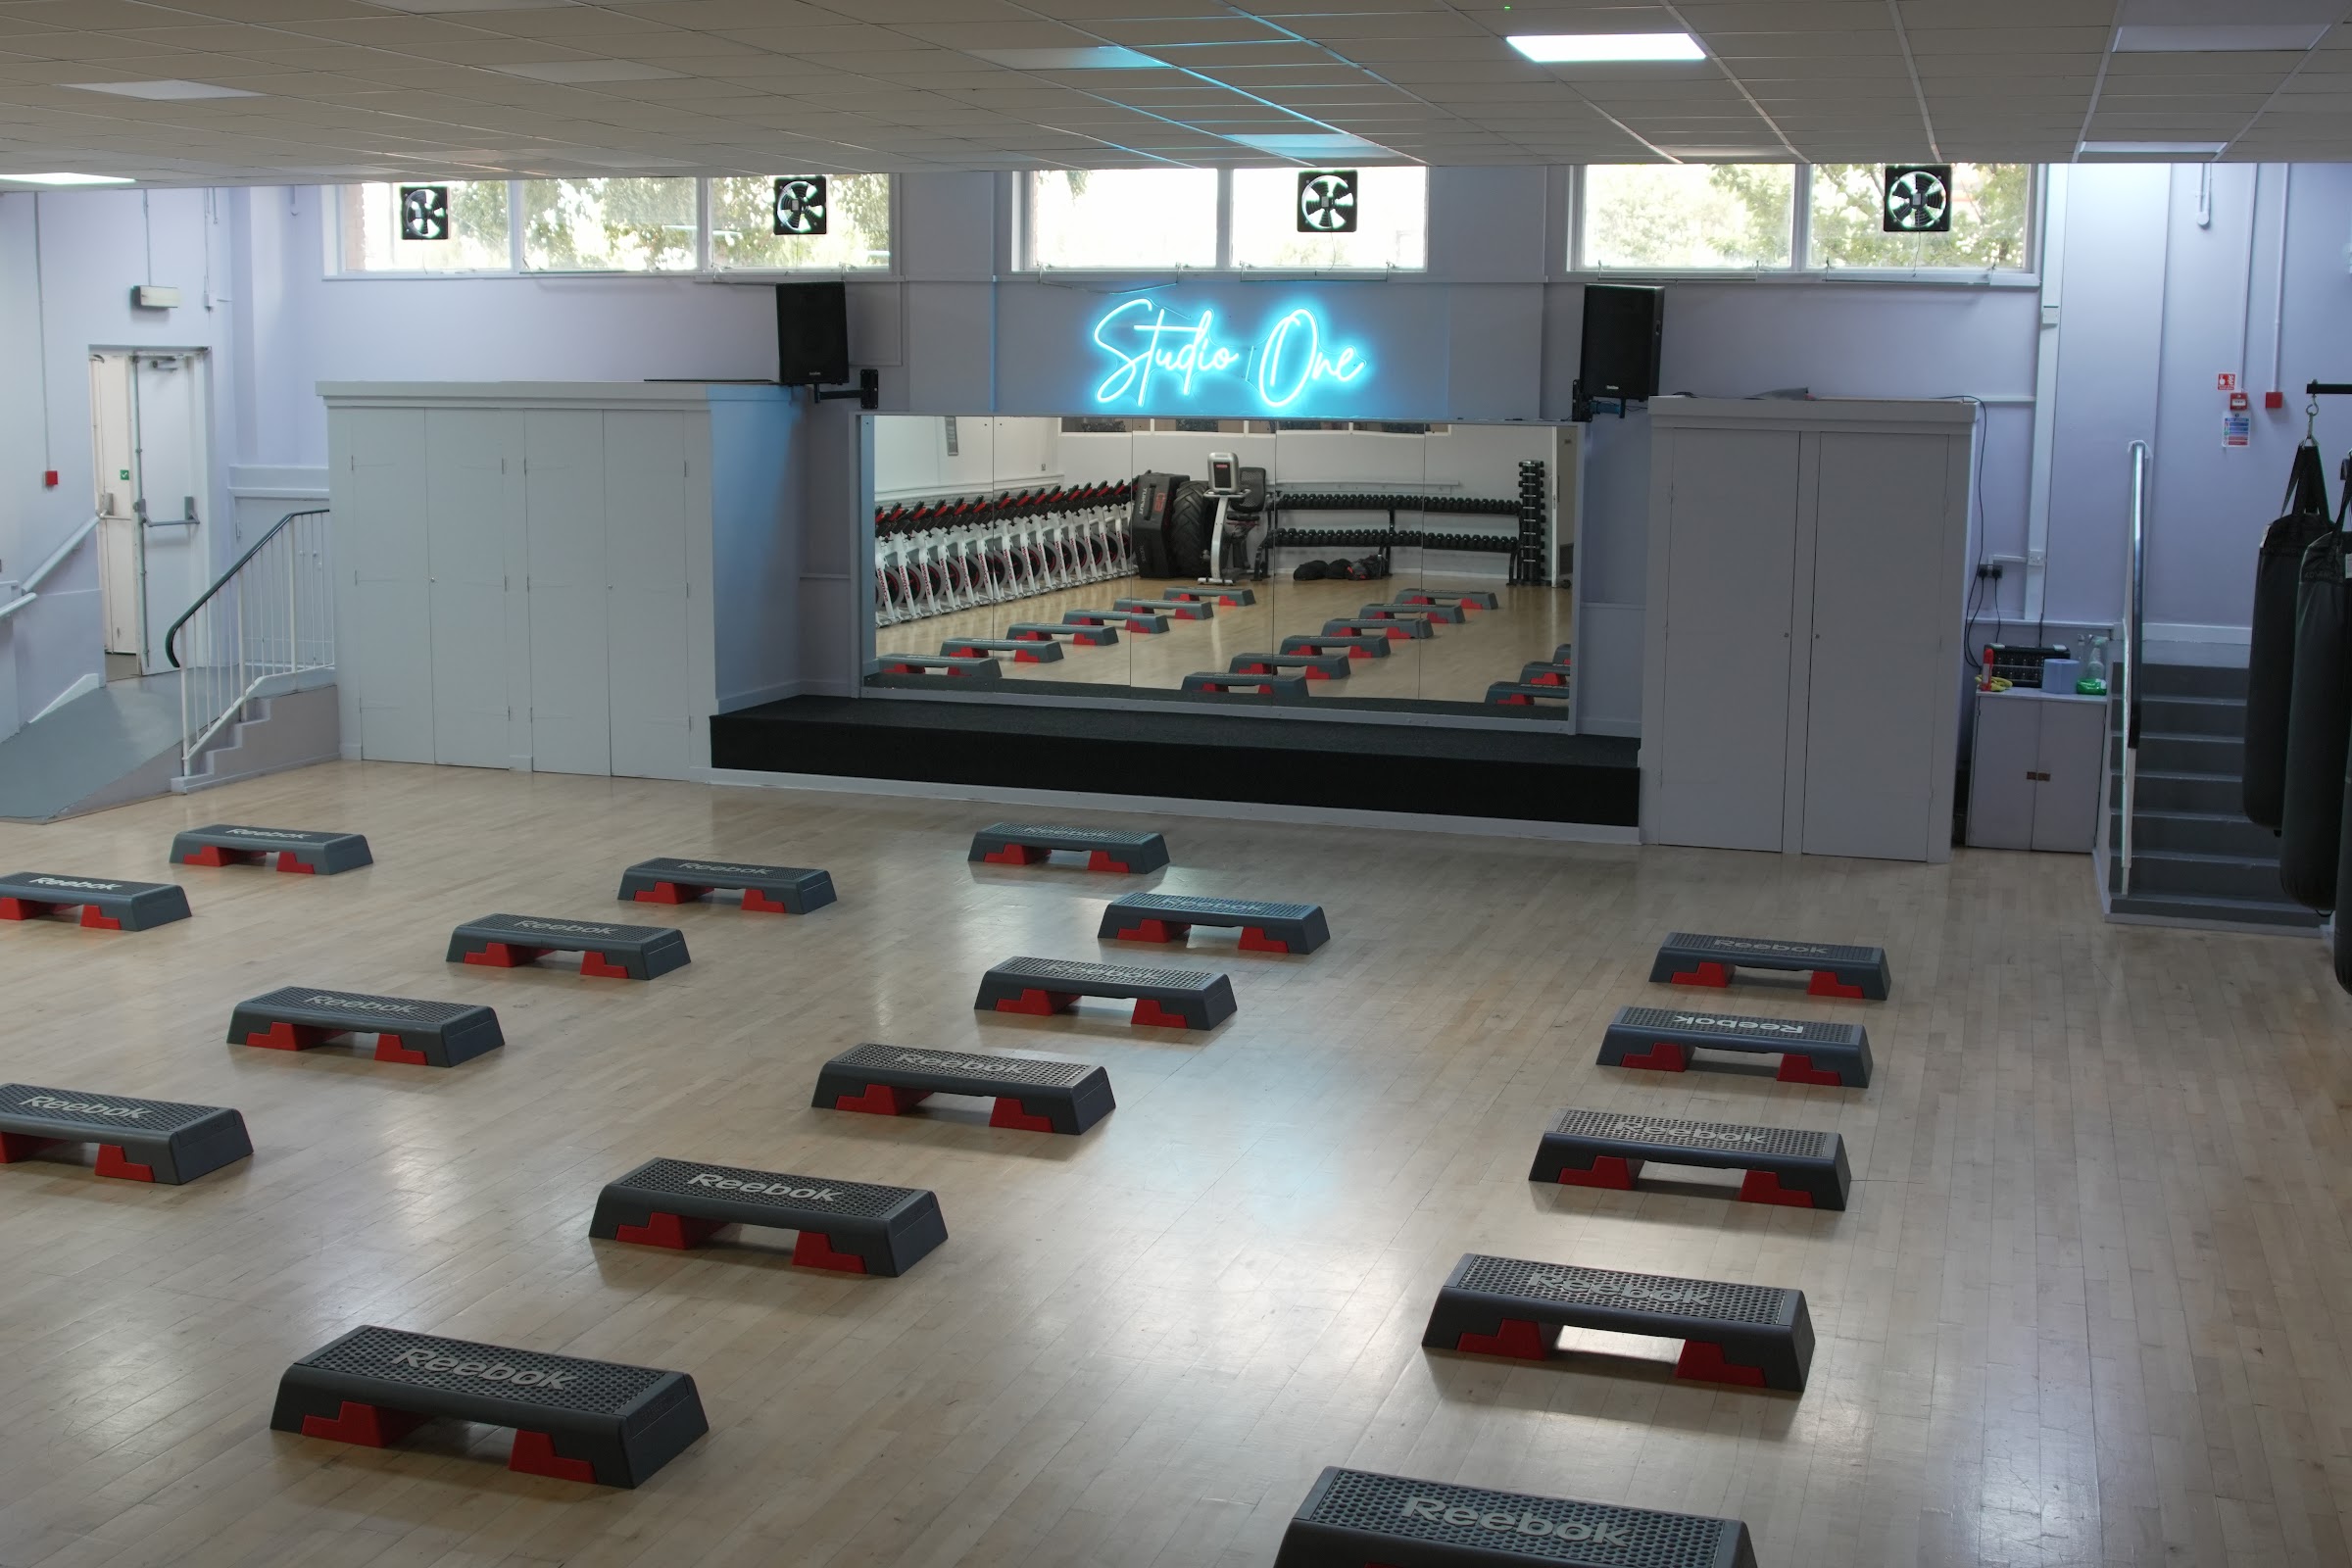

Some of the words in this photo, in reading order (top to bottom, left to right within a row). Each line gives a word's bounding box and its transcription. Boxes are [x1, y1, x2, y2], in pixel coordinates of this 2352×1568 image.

[1094, 298, 1240, 406] Studio
[1258, 308, 1367, 408] One
[224, 828, 312, 840] Reebok
[676, 862, 775, 875] Reebok
[27, 877, 122, 891] Reebok
[514, 919, 619, 935] Reebok
[1715, 939, 1829, 955] Reebok
[302, 995, 421, 1014] Reebok
[1673, 1014, 1804, 1034] Reebok
[895, 1054, 1030, 1075] Reebok
[20, 1096, 154, 1119] Reebok
[1618, 1122, 1768, 1145] Reebok
[686, 1173, 846, 1202] Reebok
[1527, 1272, 1714, 1308] Reebok
[392, 1348, 581, 1392] Reebok
[1401, 1495, 1636, 1548] Reebok
